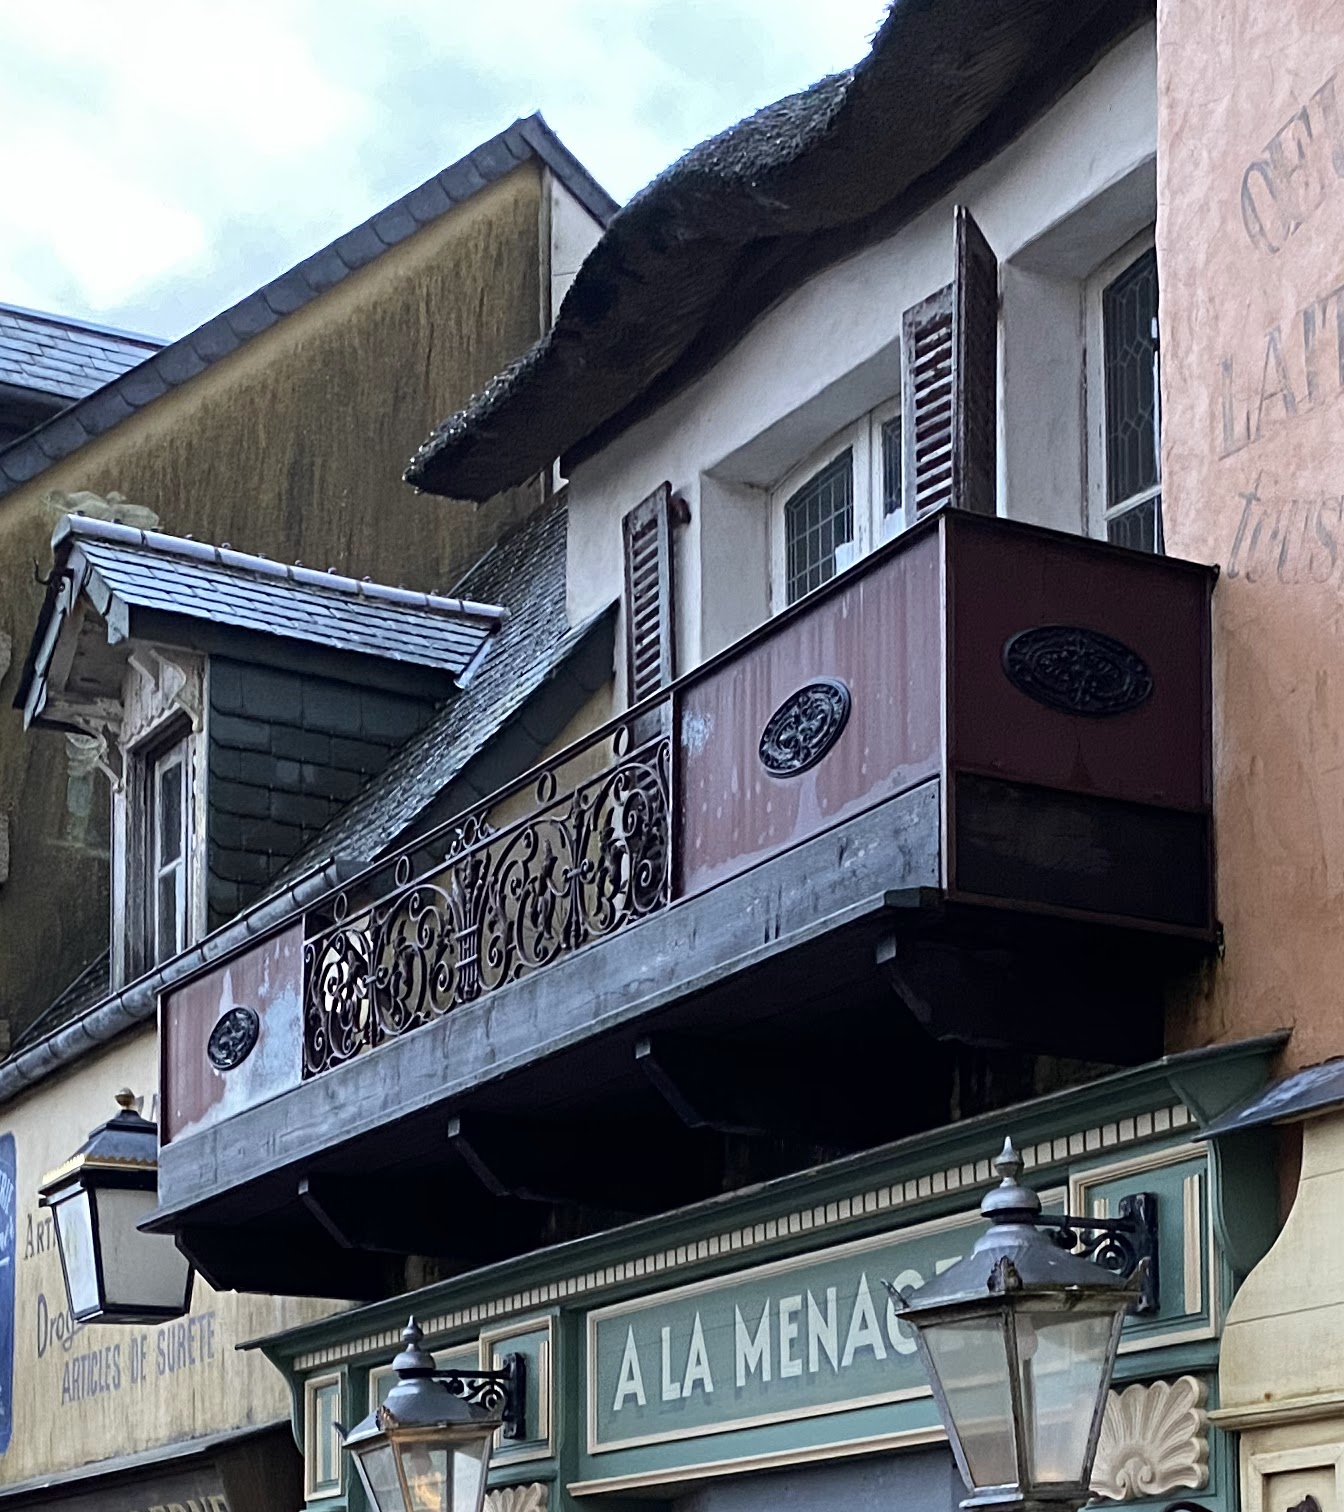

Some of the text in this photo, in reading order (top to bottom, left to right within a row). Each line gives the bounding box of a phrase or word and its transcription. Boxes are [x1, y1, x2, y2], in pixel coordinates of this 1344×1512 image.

[61, 1344, 122, 1406] ARTICLES
[130, 1333, 148, 1385] DE
[612, 1256, 963, 1411] A LA MENAG
